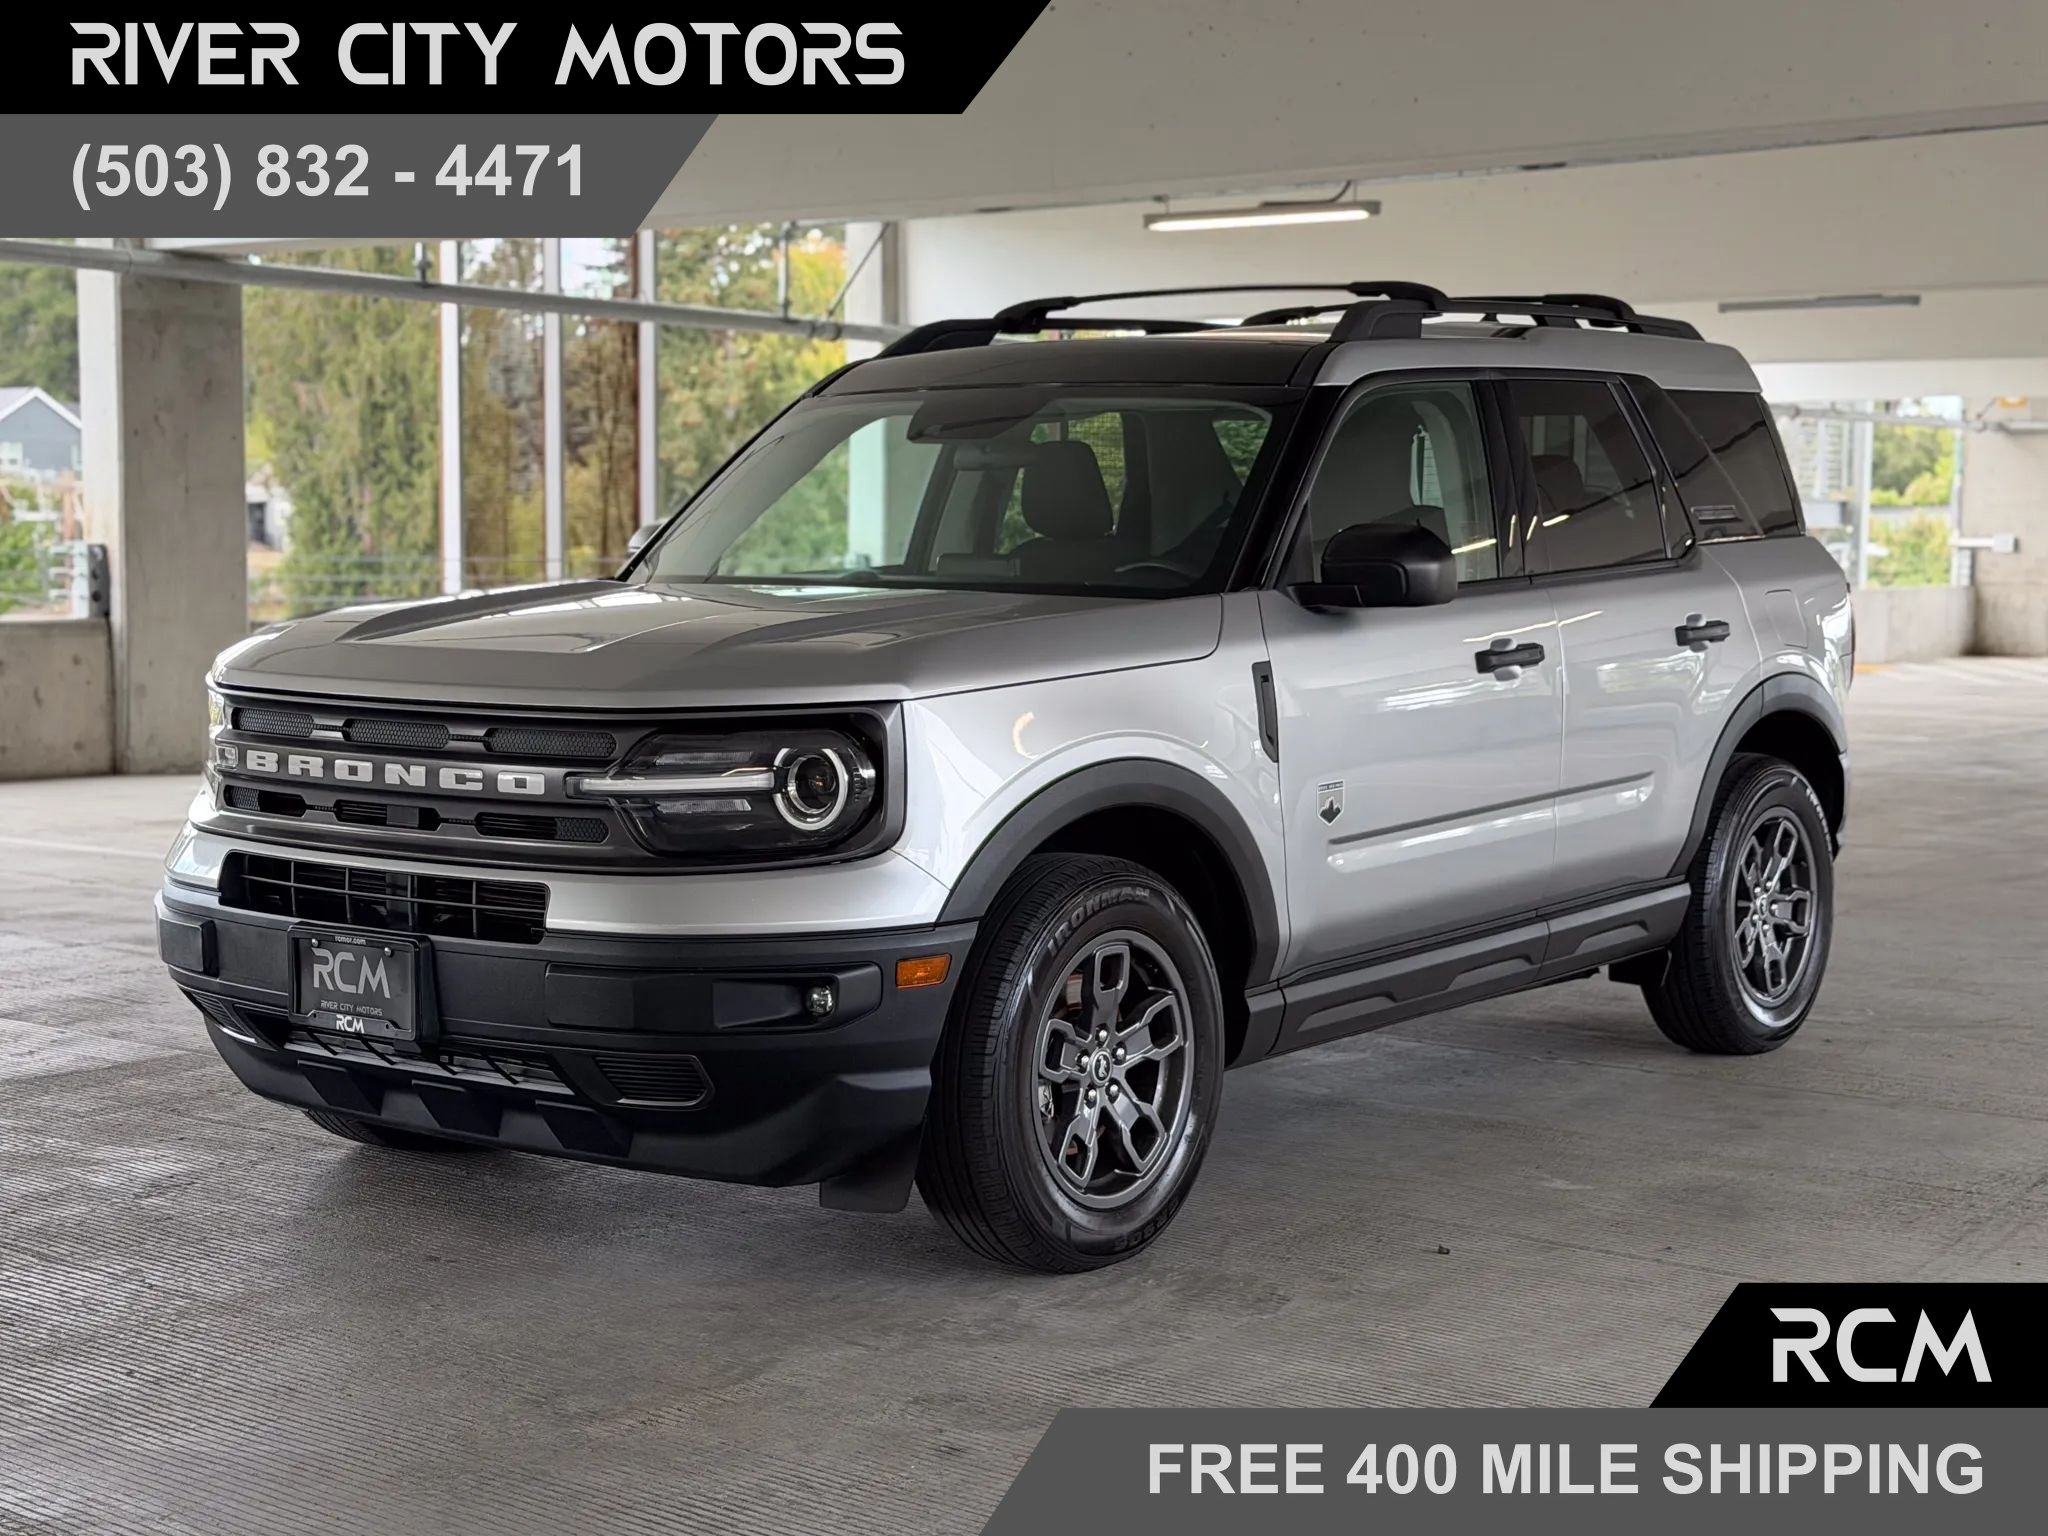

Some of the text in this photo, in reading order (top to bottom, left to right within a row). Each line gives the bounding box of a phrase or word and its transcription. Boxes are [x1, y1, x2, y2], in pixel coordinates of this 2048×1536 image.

[246, 749, 545, 796] BRONCO
[311, 947, 391, 999] RCM
[320, 999, 383, 1016] RIVER CITY MOTORS
[336, 1014, 365, 1033] RCM
